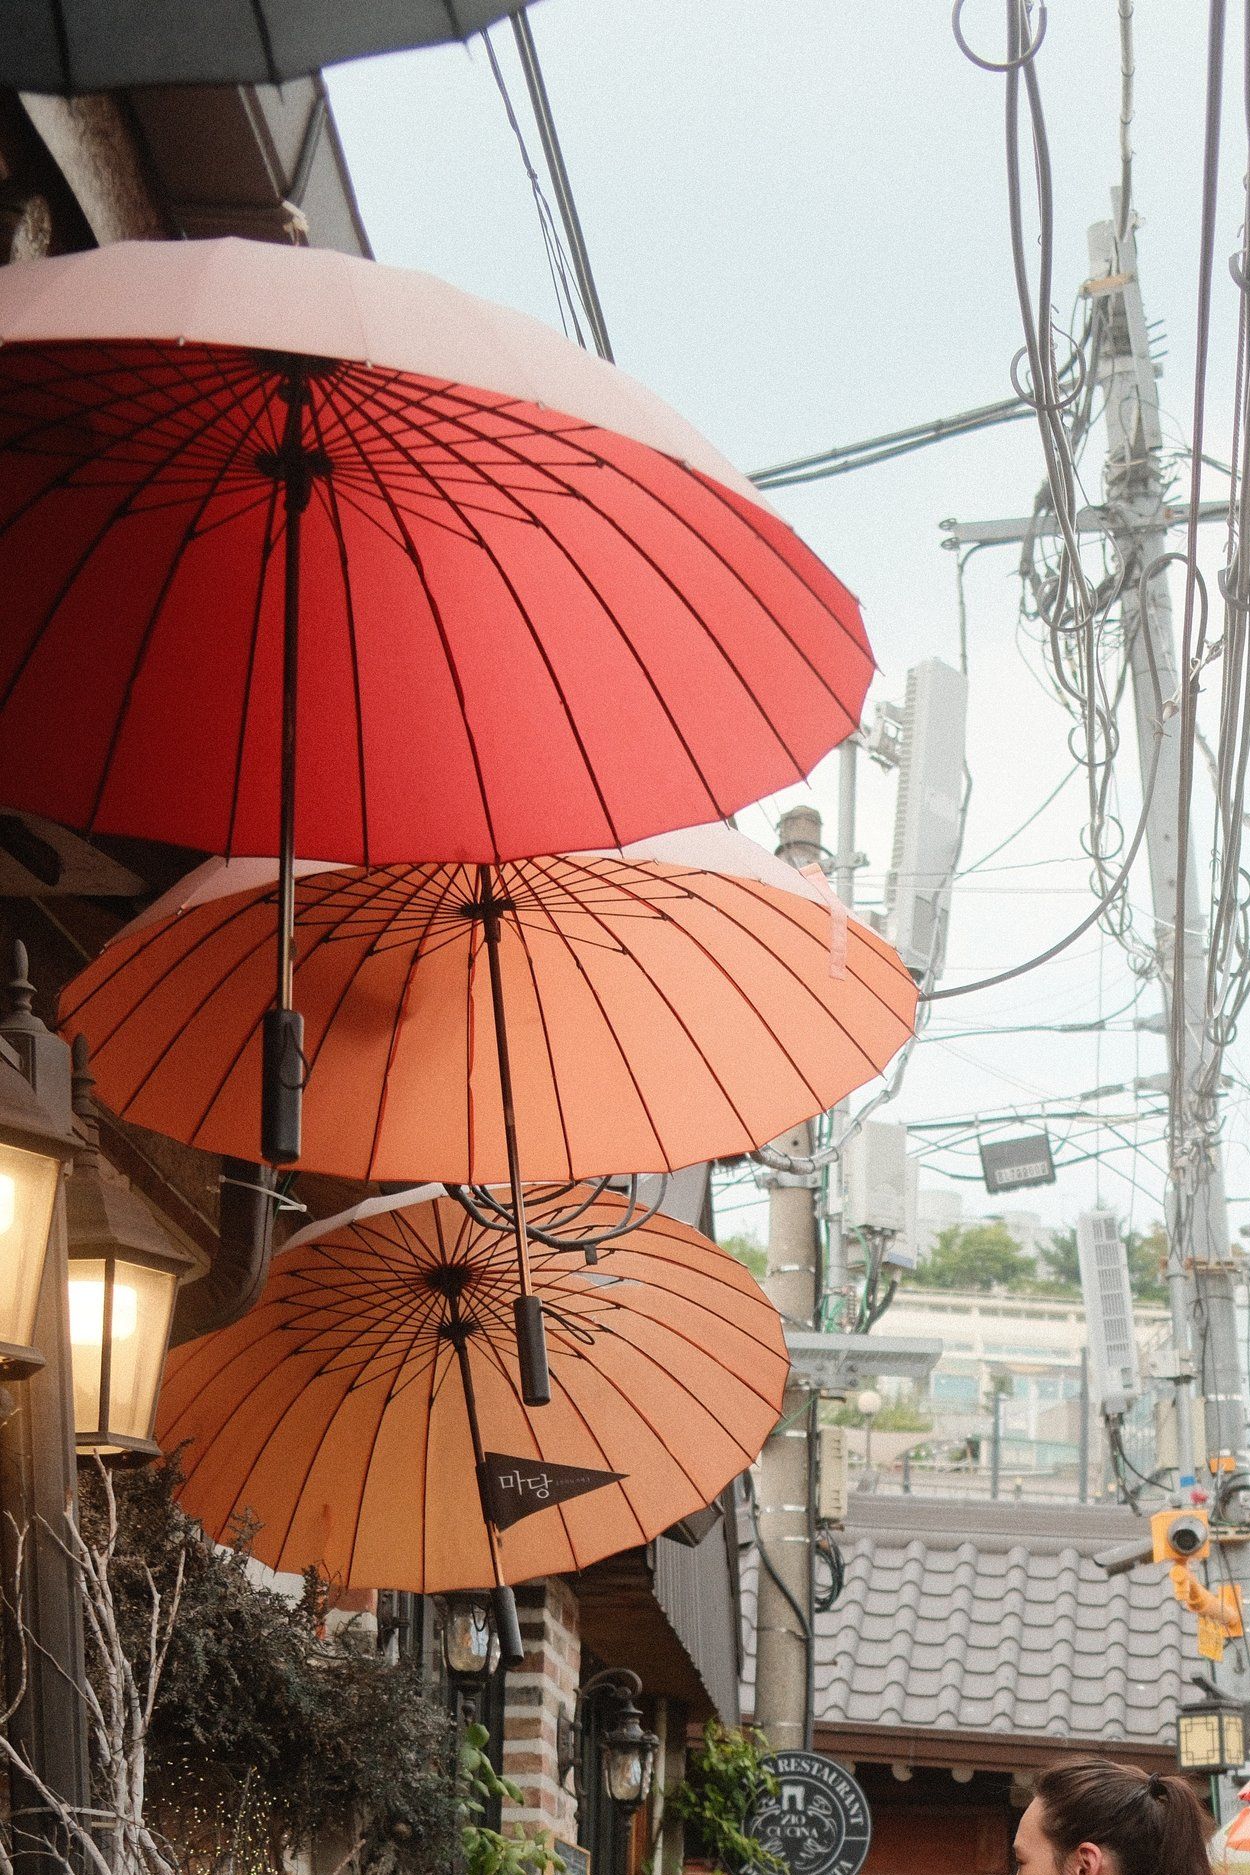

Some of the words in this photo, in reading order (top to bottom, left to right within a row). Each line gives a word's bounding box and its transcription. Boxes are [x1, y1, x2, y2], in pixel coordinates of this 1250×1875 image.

[498, 1469, 553, 1499] 마당
[777, 1757, 864, 1826] RESTAURANT
[780, 1813, 807, 1826] ZIO
[766, 1826, 819, 1838] CUCINA
